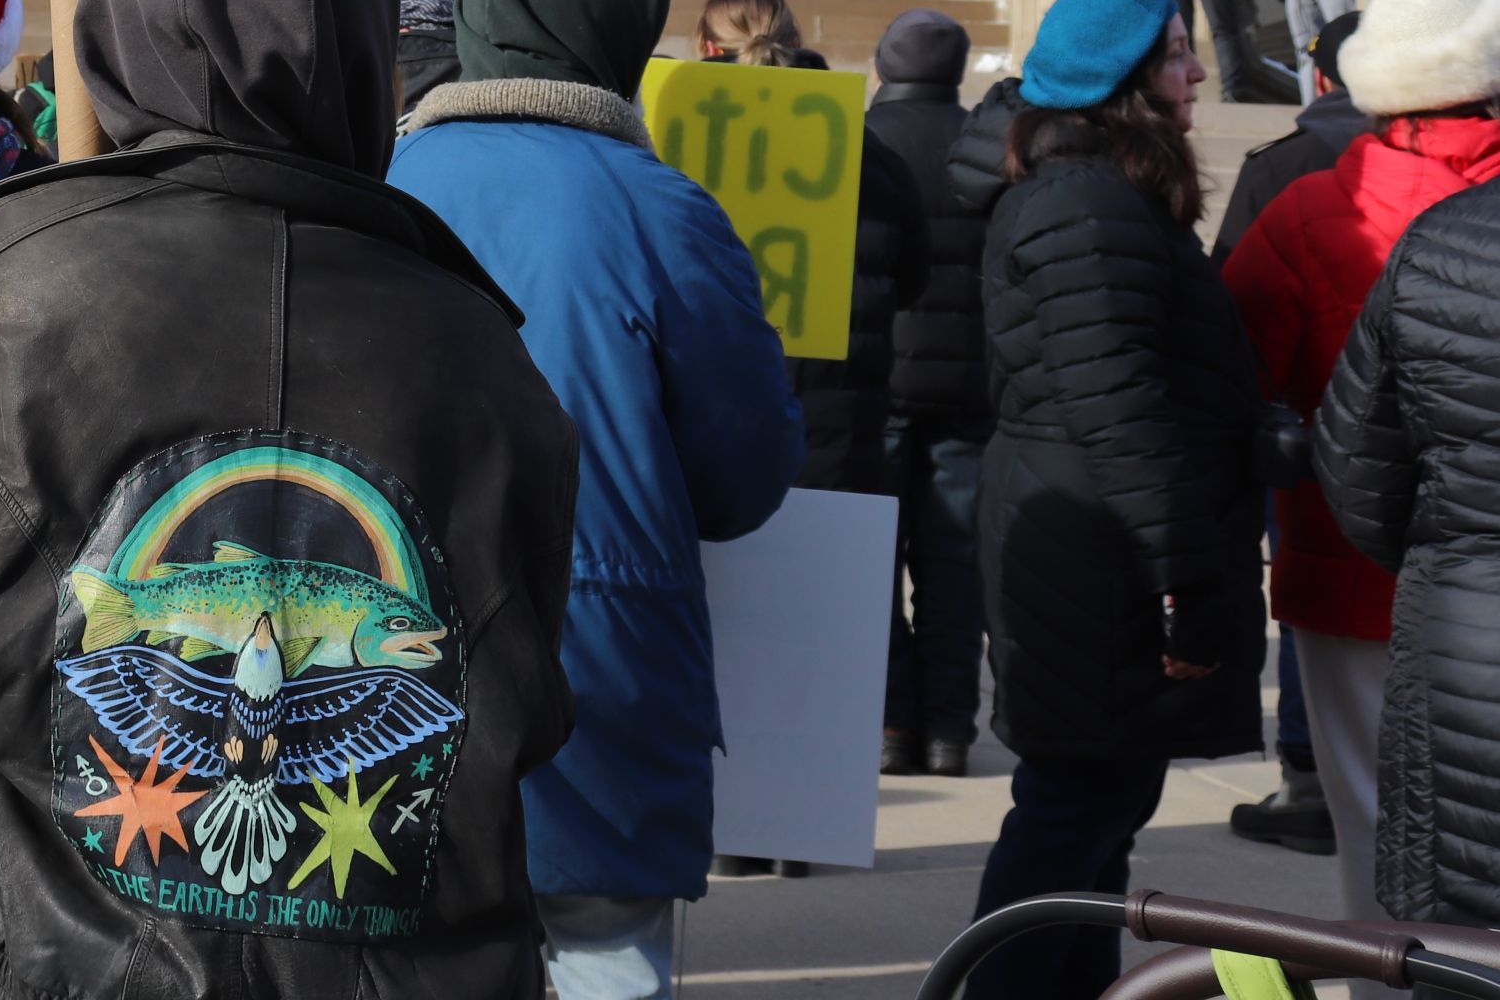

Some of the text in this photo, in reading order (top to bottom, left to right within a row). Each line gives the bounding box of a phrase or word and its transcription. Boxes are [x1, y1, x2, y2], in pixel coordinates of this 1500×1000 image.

[106, 867, 153, 905] THE
[158, 879, 234, 919] EARTH
[266, 895, 302, 927] THE
[306, 899, 359, 931] ONLY
